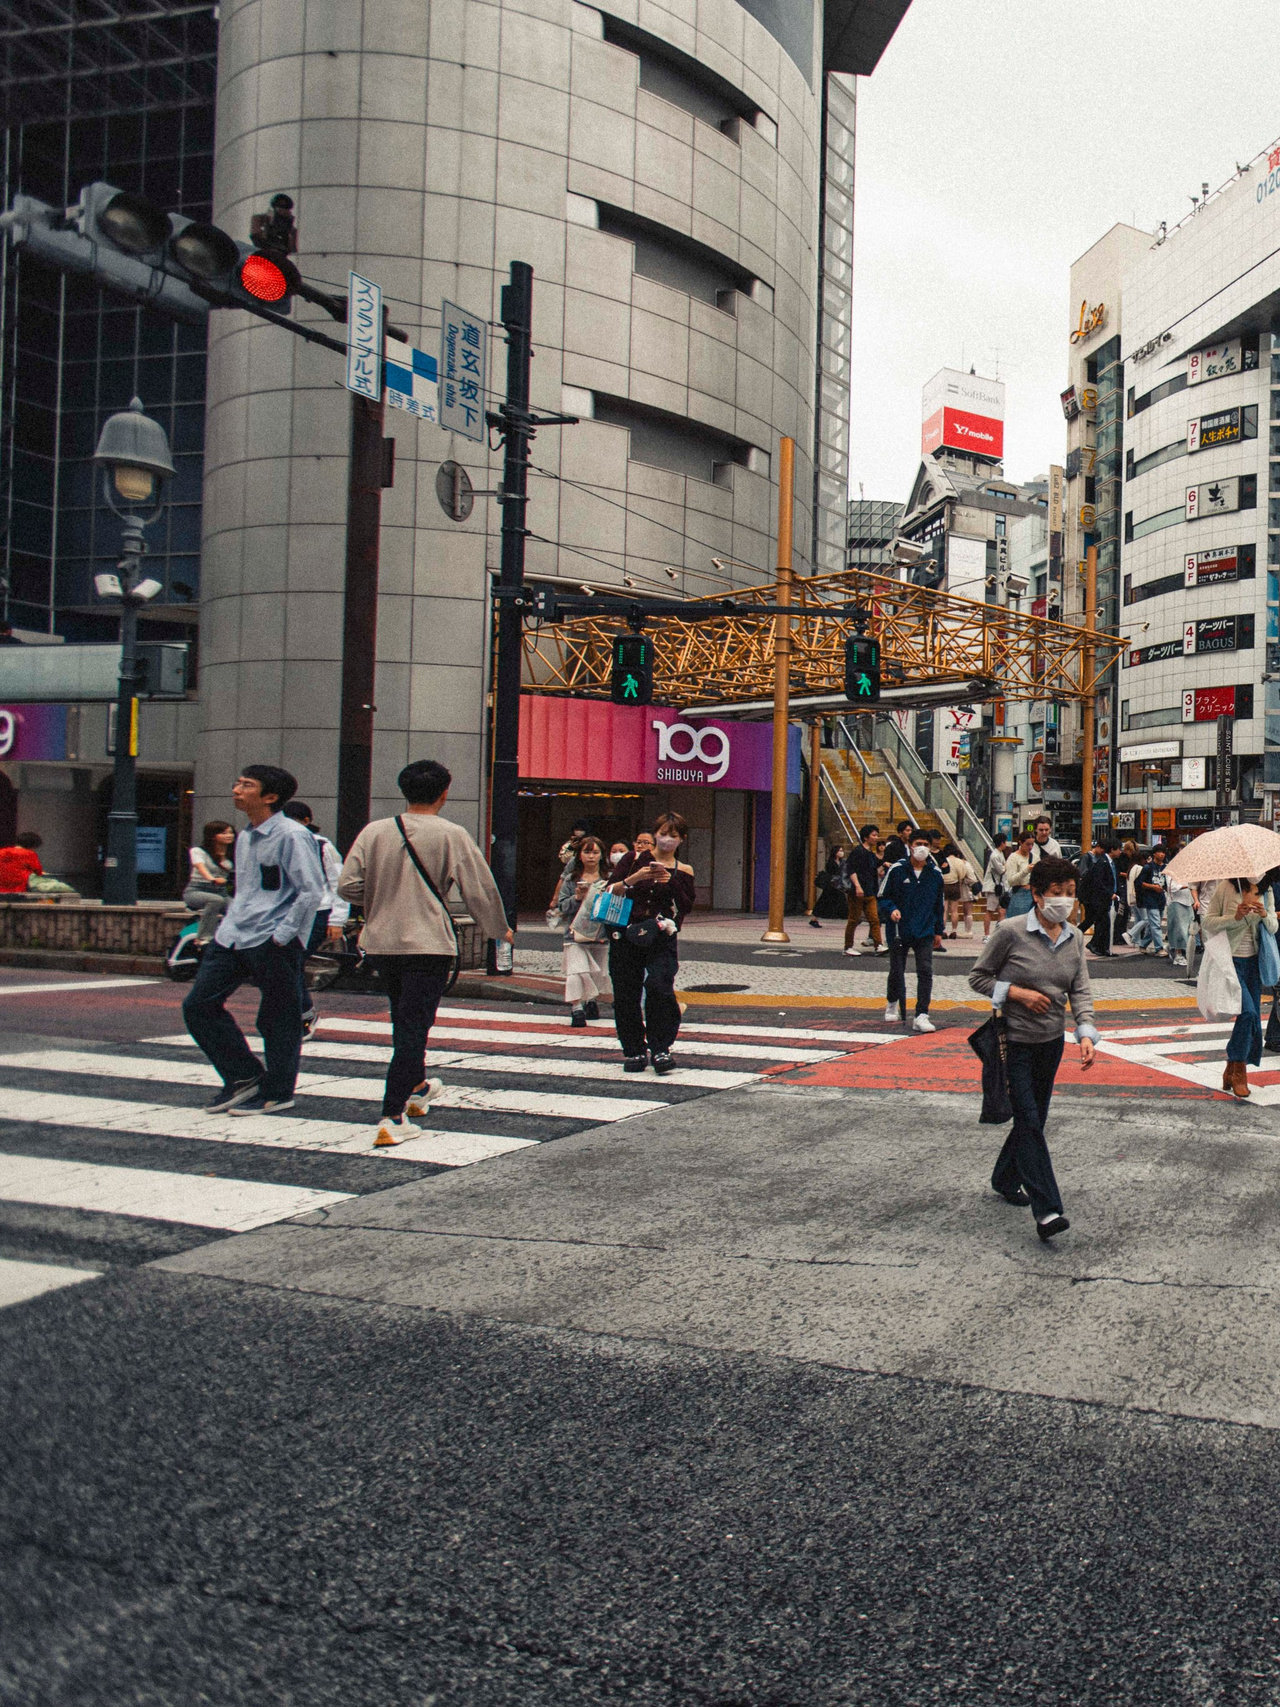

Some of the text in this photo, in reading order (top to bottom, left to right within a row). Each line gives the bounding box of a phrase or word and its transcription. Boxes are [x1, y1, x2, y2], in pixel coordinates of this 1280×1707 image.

[445, 323, 459, 408] Dogenzaka shita
[459, 320, 482, 428] 道玄坂下
[388, 389, 436, 423] 時差式
[961, 387, 1001, 405] SoftBank
[1083, 388, 1098, 409] 8
[1082, 448, 1096, 470] 7
[1081, 505, 1096, 526] 6
[1198, 619, 1234, 633] ダーツバー
[1148, 643, 1182, 660] ダーツバー
[1198, 637, 1234, 651] BAGUS
[1199, 702, 1235, 714] クリニック
[652, 720, 730, 783] 109
[657, 767, 704, 783] SHIBUYA
